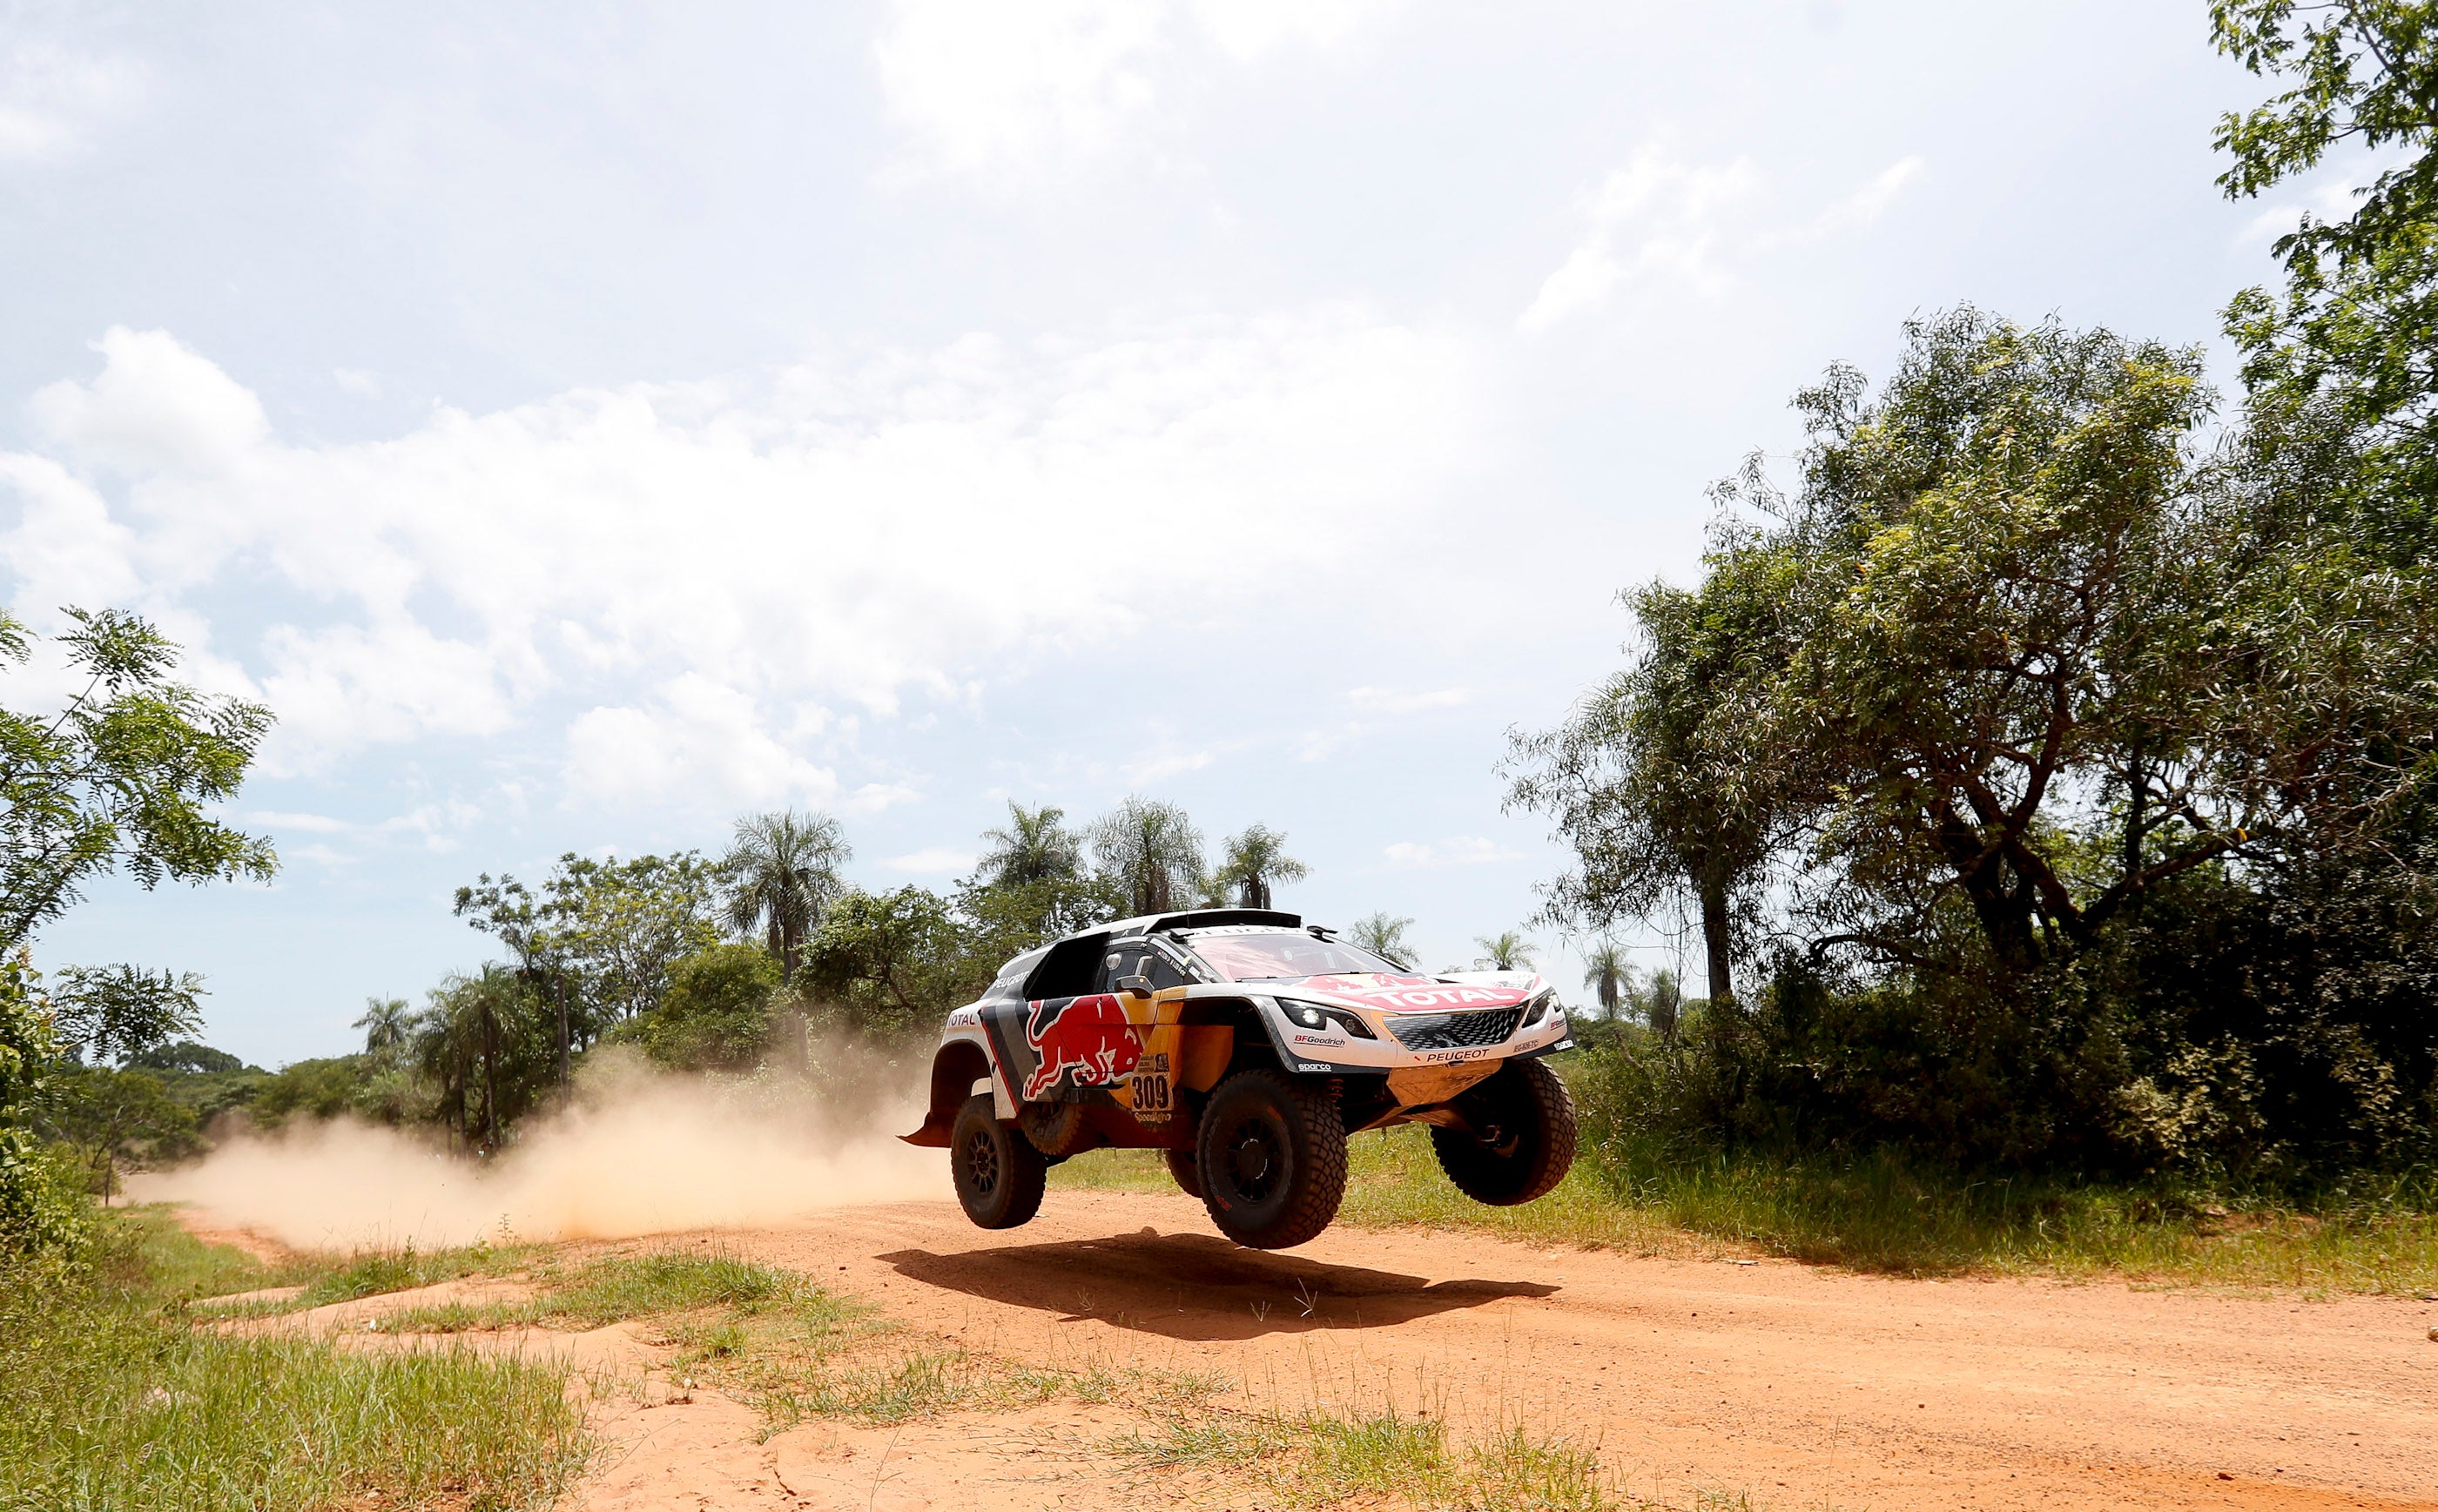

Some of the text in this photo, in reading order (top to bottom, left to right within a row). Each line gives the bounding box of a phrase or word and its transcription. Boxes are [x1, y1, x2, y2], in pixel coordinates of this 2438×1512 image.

[1364, 987, 1515, 1007] TOTAL
[948, 1012, 975, 1026] TOTAL
[1295, 1034, 1345, 1046] BFGoodrich
[1427, 1049, 1490, 1062] PEUGEOT
[1298, 1063, 1331, 1072] sparco
[1132, 1075, 1169, 1109] 309
